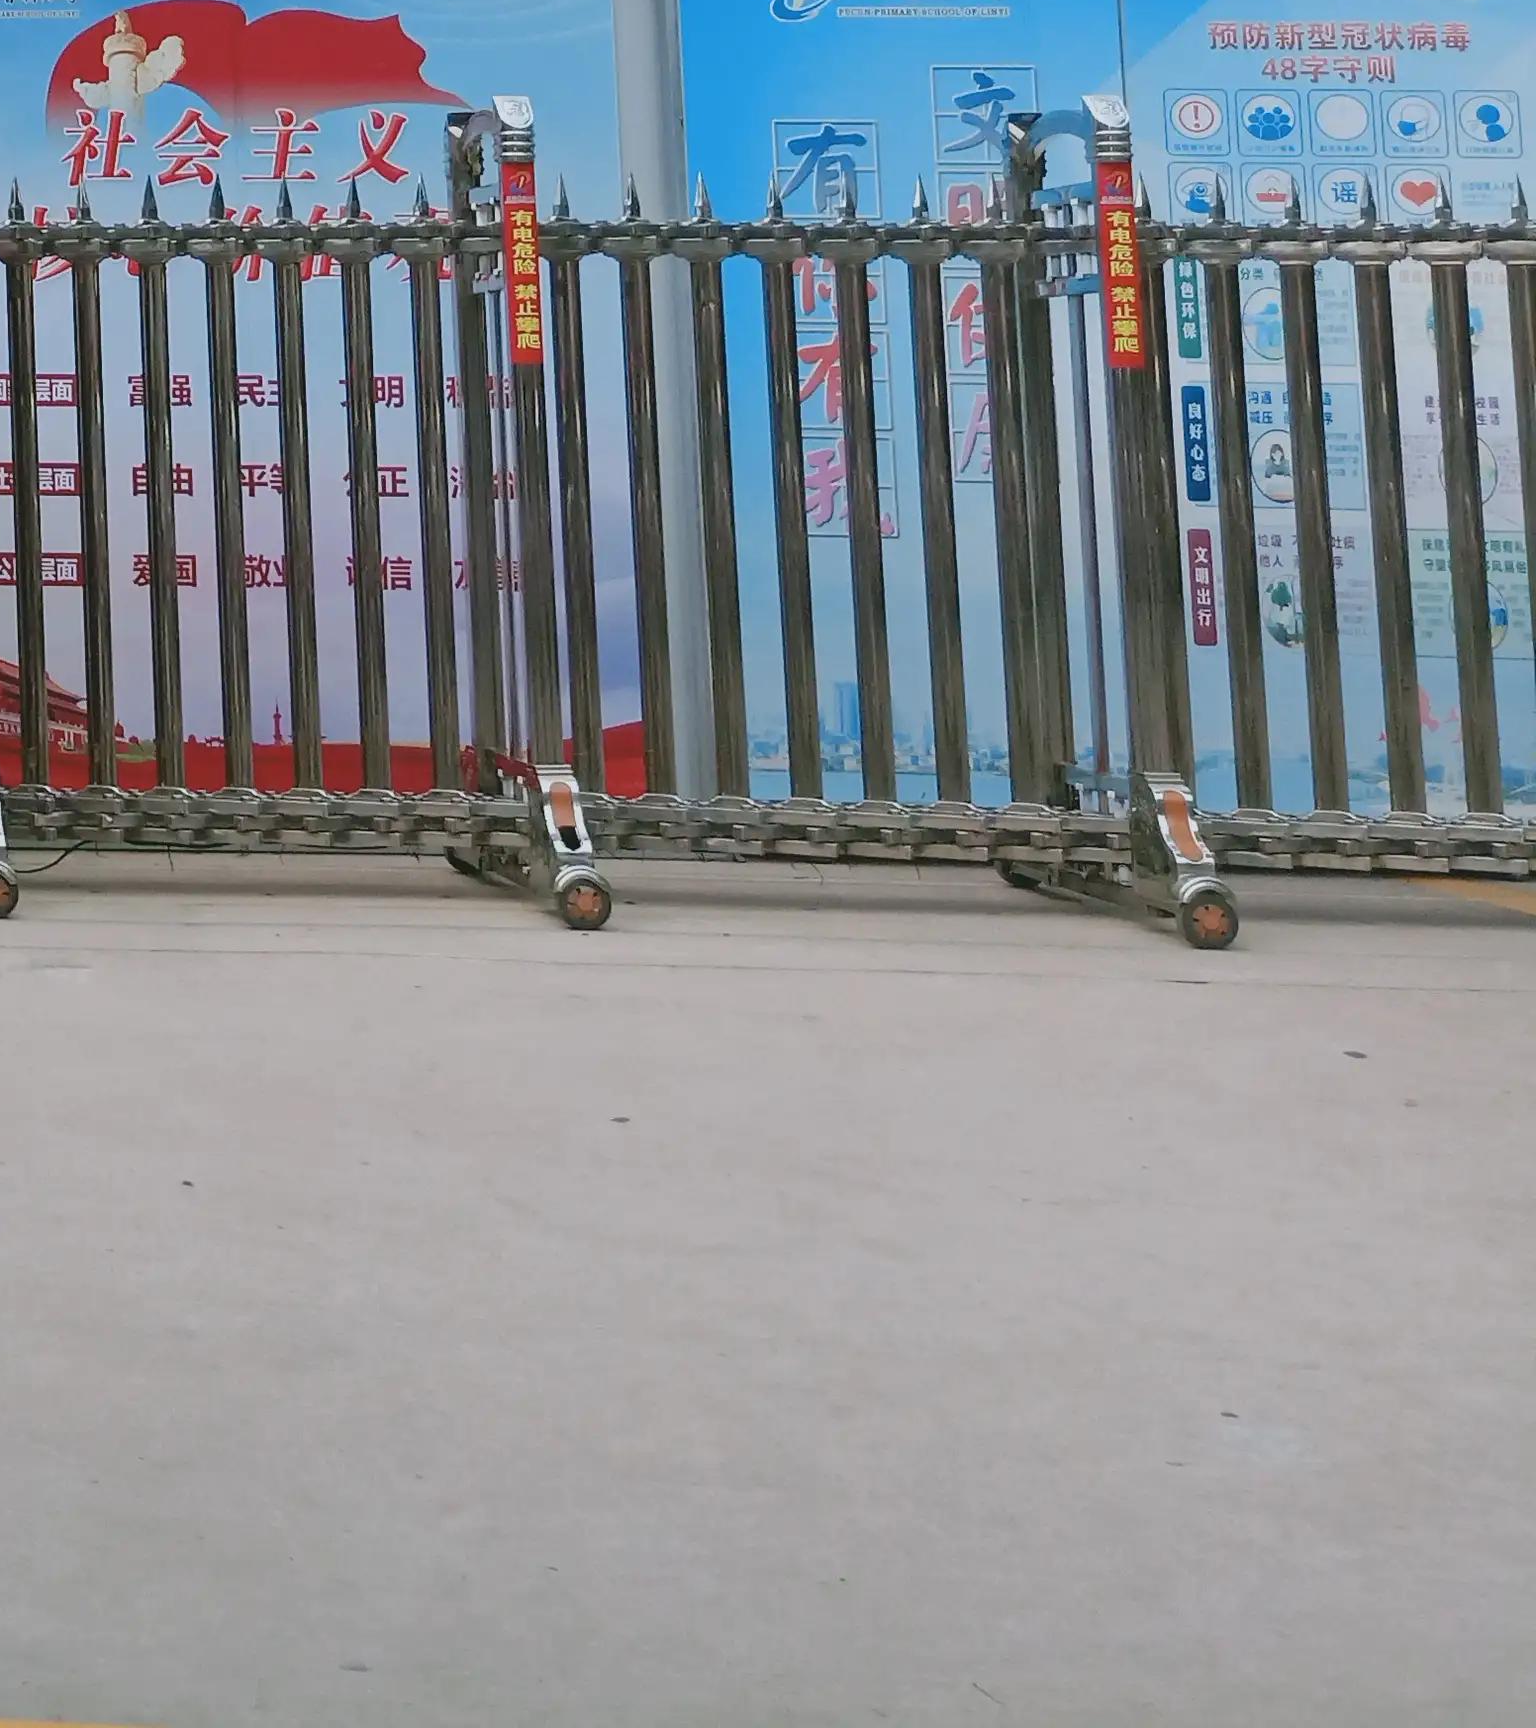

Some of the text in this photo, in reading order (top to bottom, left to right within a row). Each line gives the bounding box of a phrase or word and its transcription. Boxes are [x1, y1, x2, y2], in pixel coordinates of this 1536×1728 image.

[1208, 21, 1471, 52] 预防新型冠状病毒
[1261, 56, 1396, 84] 48字守则
[62, 107, 410, 187] 社会主义
[1331, 181, 1358, 204] 谣
[510, 210, 537, 275] 有电危险
[1106, 210, 1134, 277] 有电危险
[339, 375, 405, 408] 明
[1188, 402, 1206, 482] 良好心态
[343, 465, 410, 499] 正
[346, 555, 413, 591] 信
[1194, 546, 1212, 627] 文明出行
